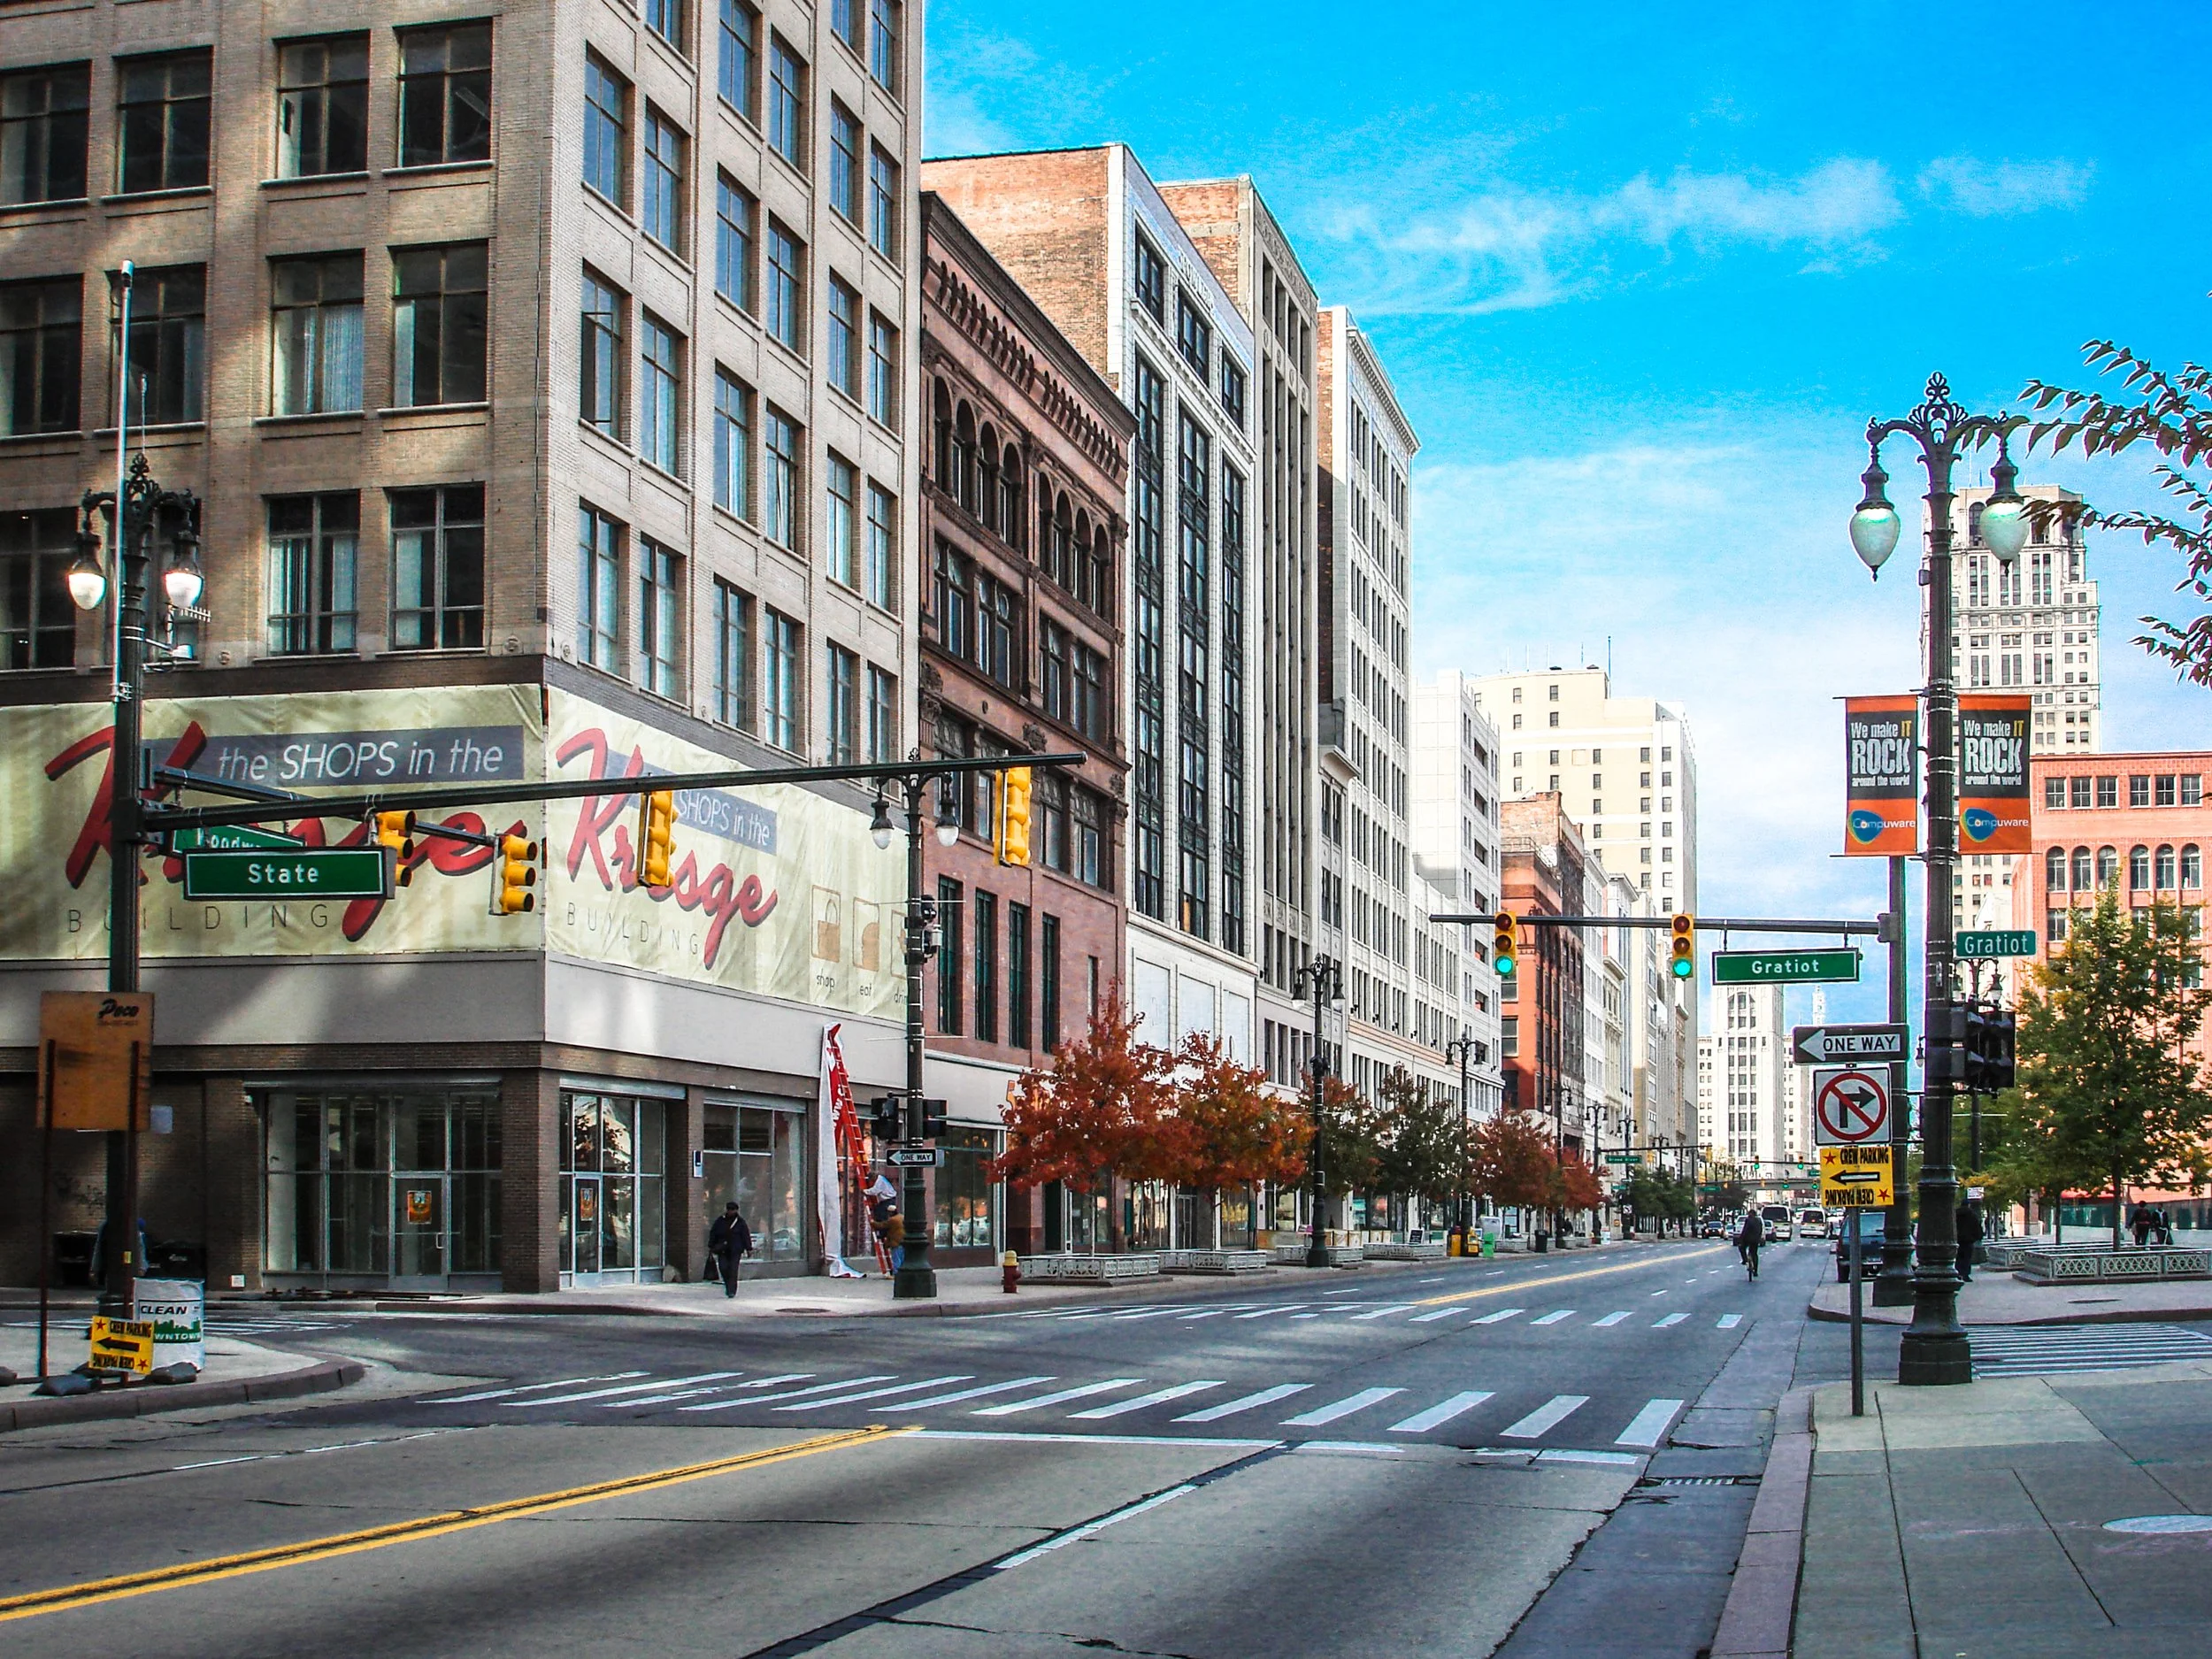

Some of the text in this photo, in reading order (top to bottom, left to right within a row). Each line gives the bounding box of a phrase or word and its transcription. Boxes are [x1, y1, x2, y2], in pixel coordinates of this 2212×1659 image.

[1850, 720, 1912, 738] We make IT
[1963, 720, 2024, 736] We make IT
[219, 738, 504, 781] the SHOPS in the
[1852, 738, 1910, 774] ROCK
[1964, 737, 2023, 773] ROCK
[1852, 775, 1910, 787] around the world
[1965, 774, 2022, 785] around the world
[678, 789, 770, 847] SHOPS in the
[1853, 818, 1916, 829] Compuware
[1967, 816, 2029, 827] Compuware
[556, 728, 779, 971] Krsge
[248, 863, 319, 884] State
[567, 902, 698, 955] BUILDING
[1964, 933, 2028, 955] Gratiot
[1751, 957, 1820, 974] Gratiot
[816, 967, 835, 994] shop
[859, 983, 872, 997] eat
[1824, 1035, 1895, 1051] ONE WAY
[1840, 1148, 1888, 1164] CREW PARKING
[141, 1305, 188, 1315] CLEAN
